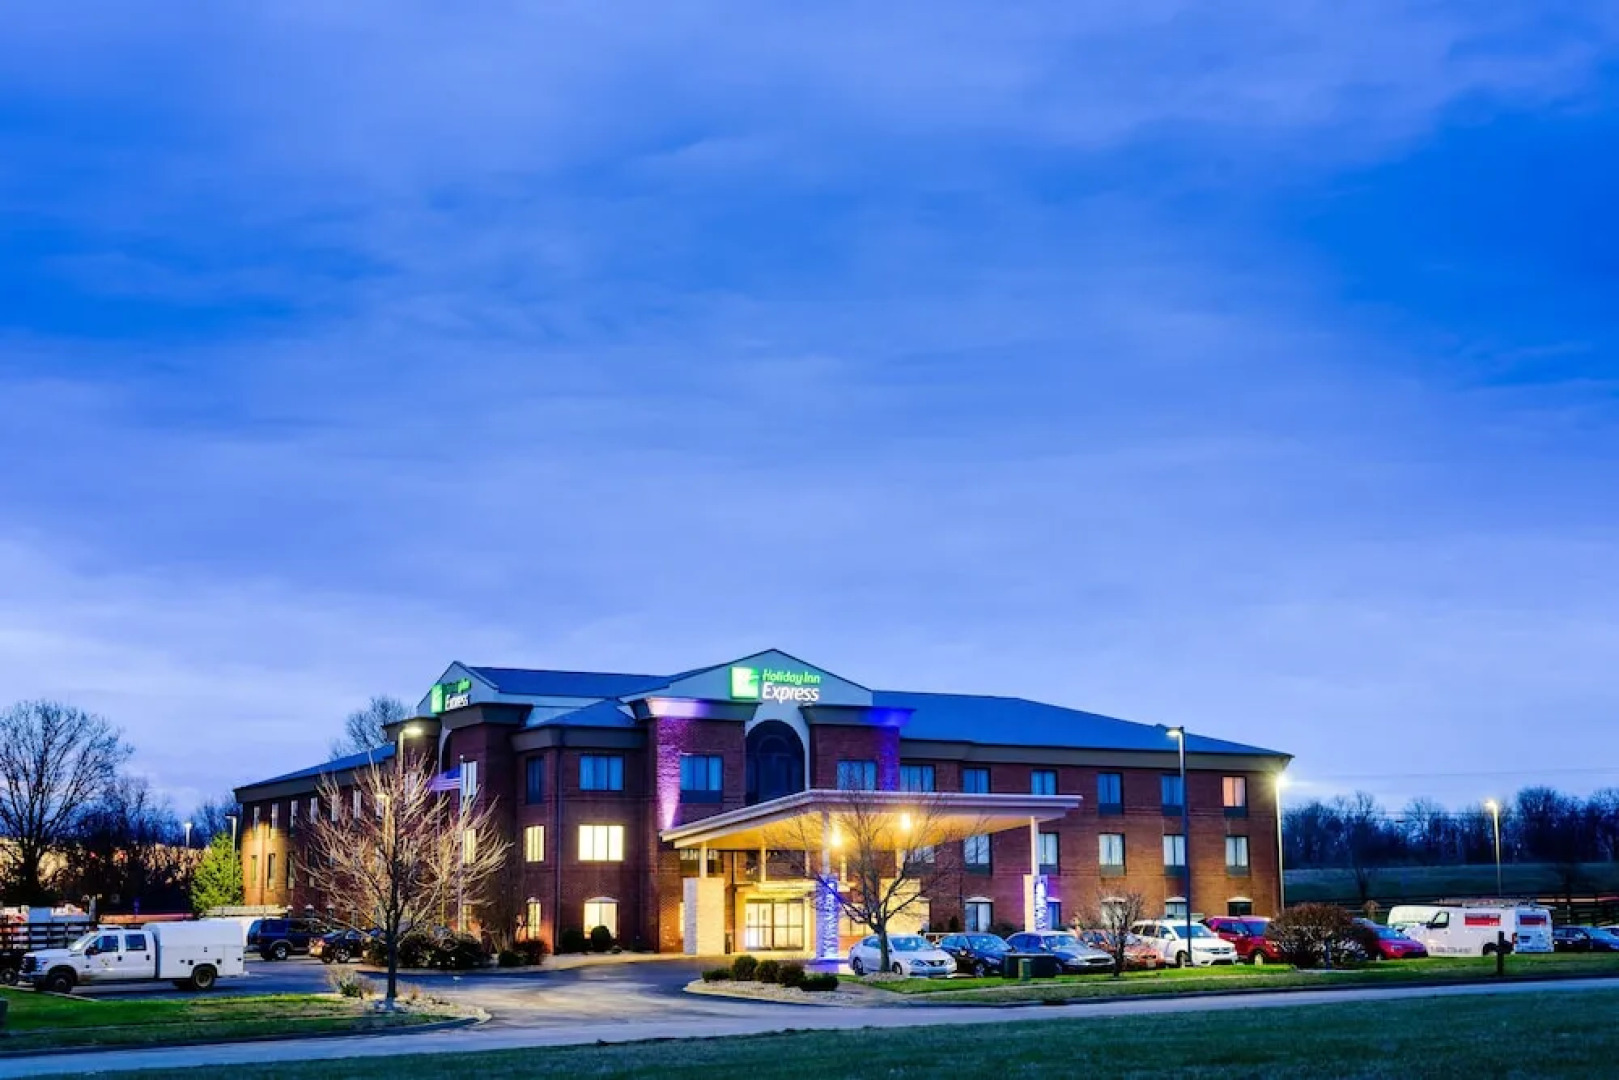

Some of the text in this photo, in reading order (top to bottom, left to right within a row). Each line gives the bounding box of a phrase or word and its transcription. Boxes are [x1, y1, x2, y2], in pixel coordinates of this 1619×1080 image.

[762, 668, 820, 685] Holiday Inn
[762, 682, 820, 704] Express
